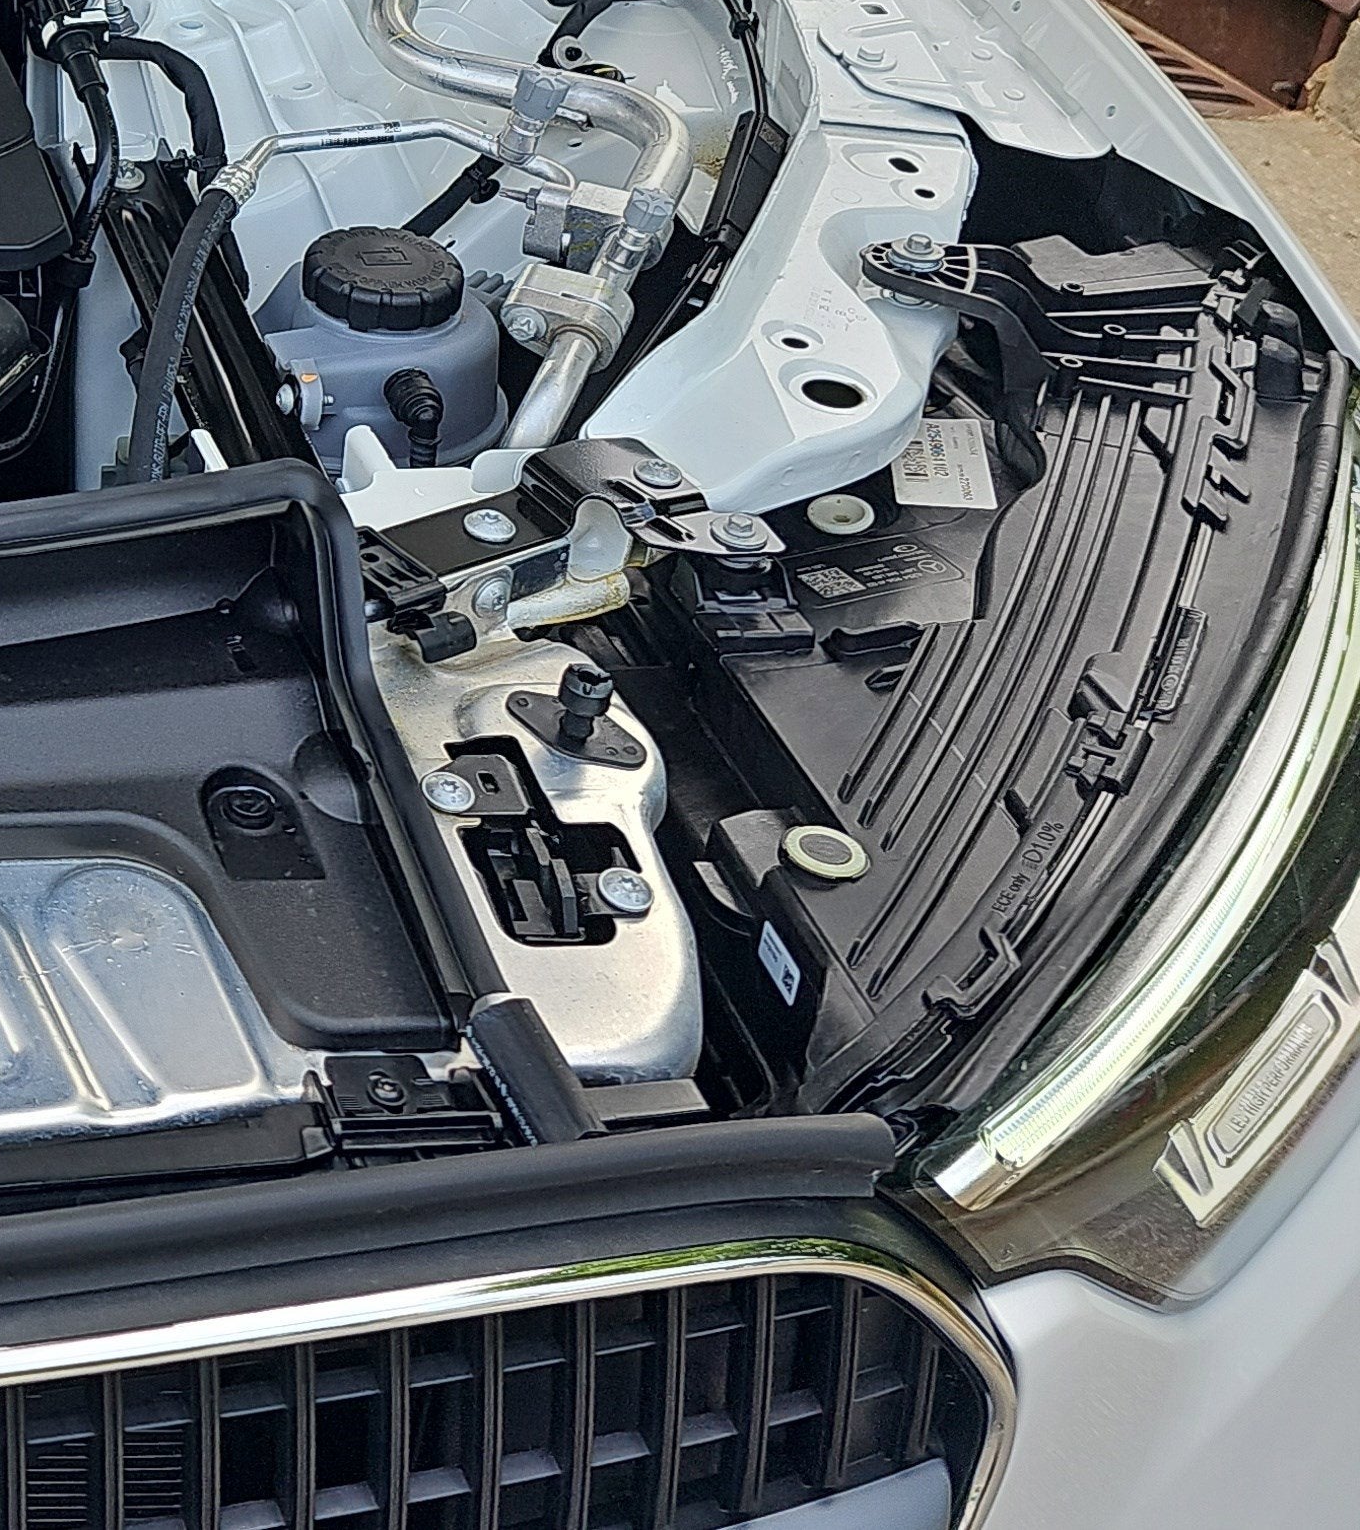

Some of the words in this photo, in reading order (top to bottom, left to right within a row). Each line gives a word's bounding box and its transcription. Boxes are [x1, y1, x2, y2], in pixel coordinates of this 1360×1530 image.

[990, 887, 1016, 915] ECE
[1005, 869, 1030, 895] only
[1253, 1020, 1318, 1094] PERFORMANCE
[1236, 1083, 1270, 1118] HIGH
[1224, 1108, 1251, 1135] LED
